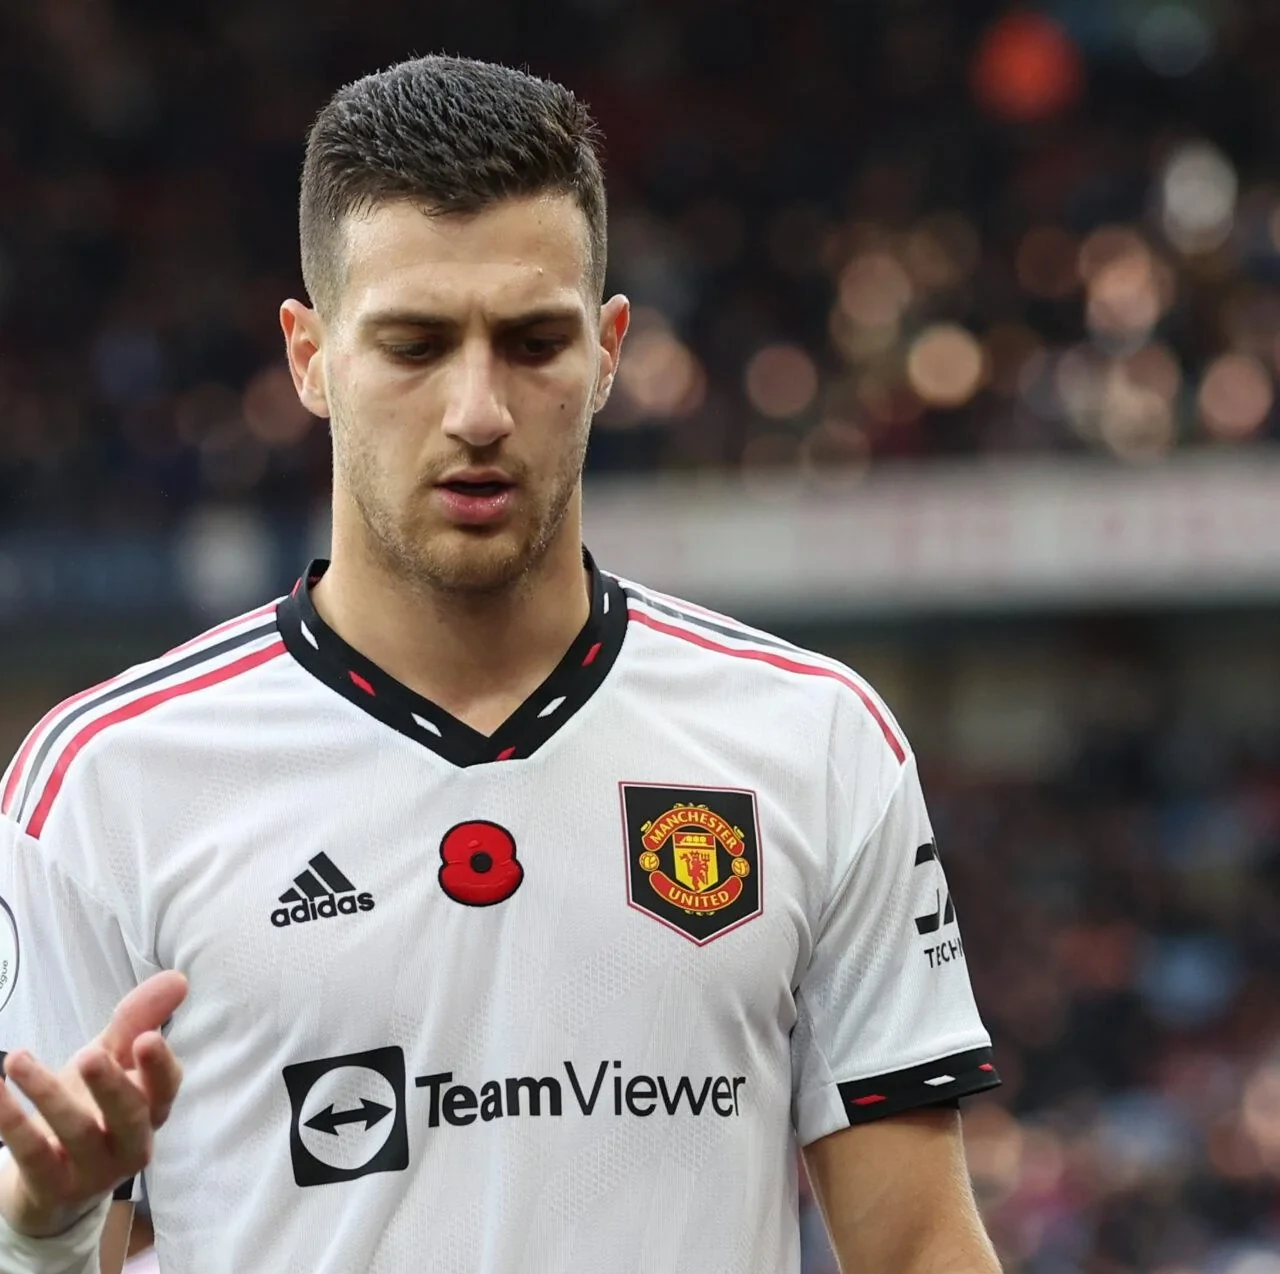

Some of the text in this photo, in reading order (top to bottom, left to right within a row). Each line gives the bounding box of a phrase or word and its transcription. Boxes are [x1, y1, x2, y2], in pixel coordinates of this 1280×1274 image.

[649, 811, 738, 849] MANCHESTER
[270, 893, 376, 928] adidas
[668, 887, 730, 908] UNITED
[415, 1060, 746, 1128] TeamViewer
